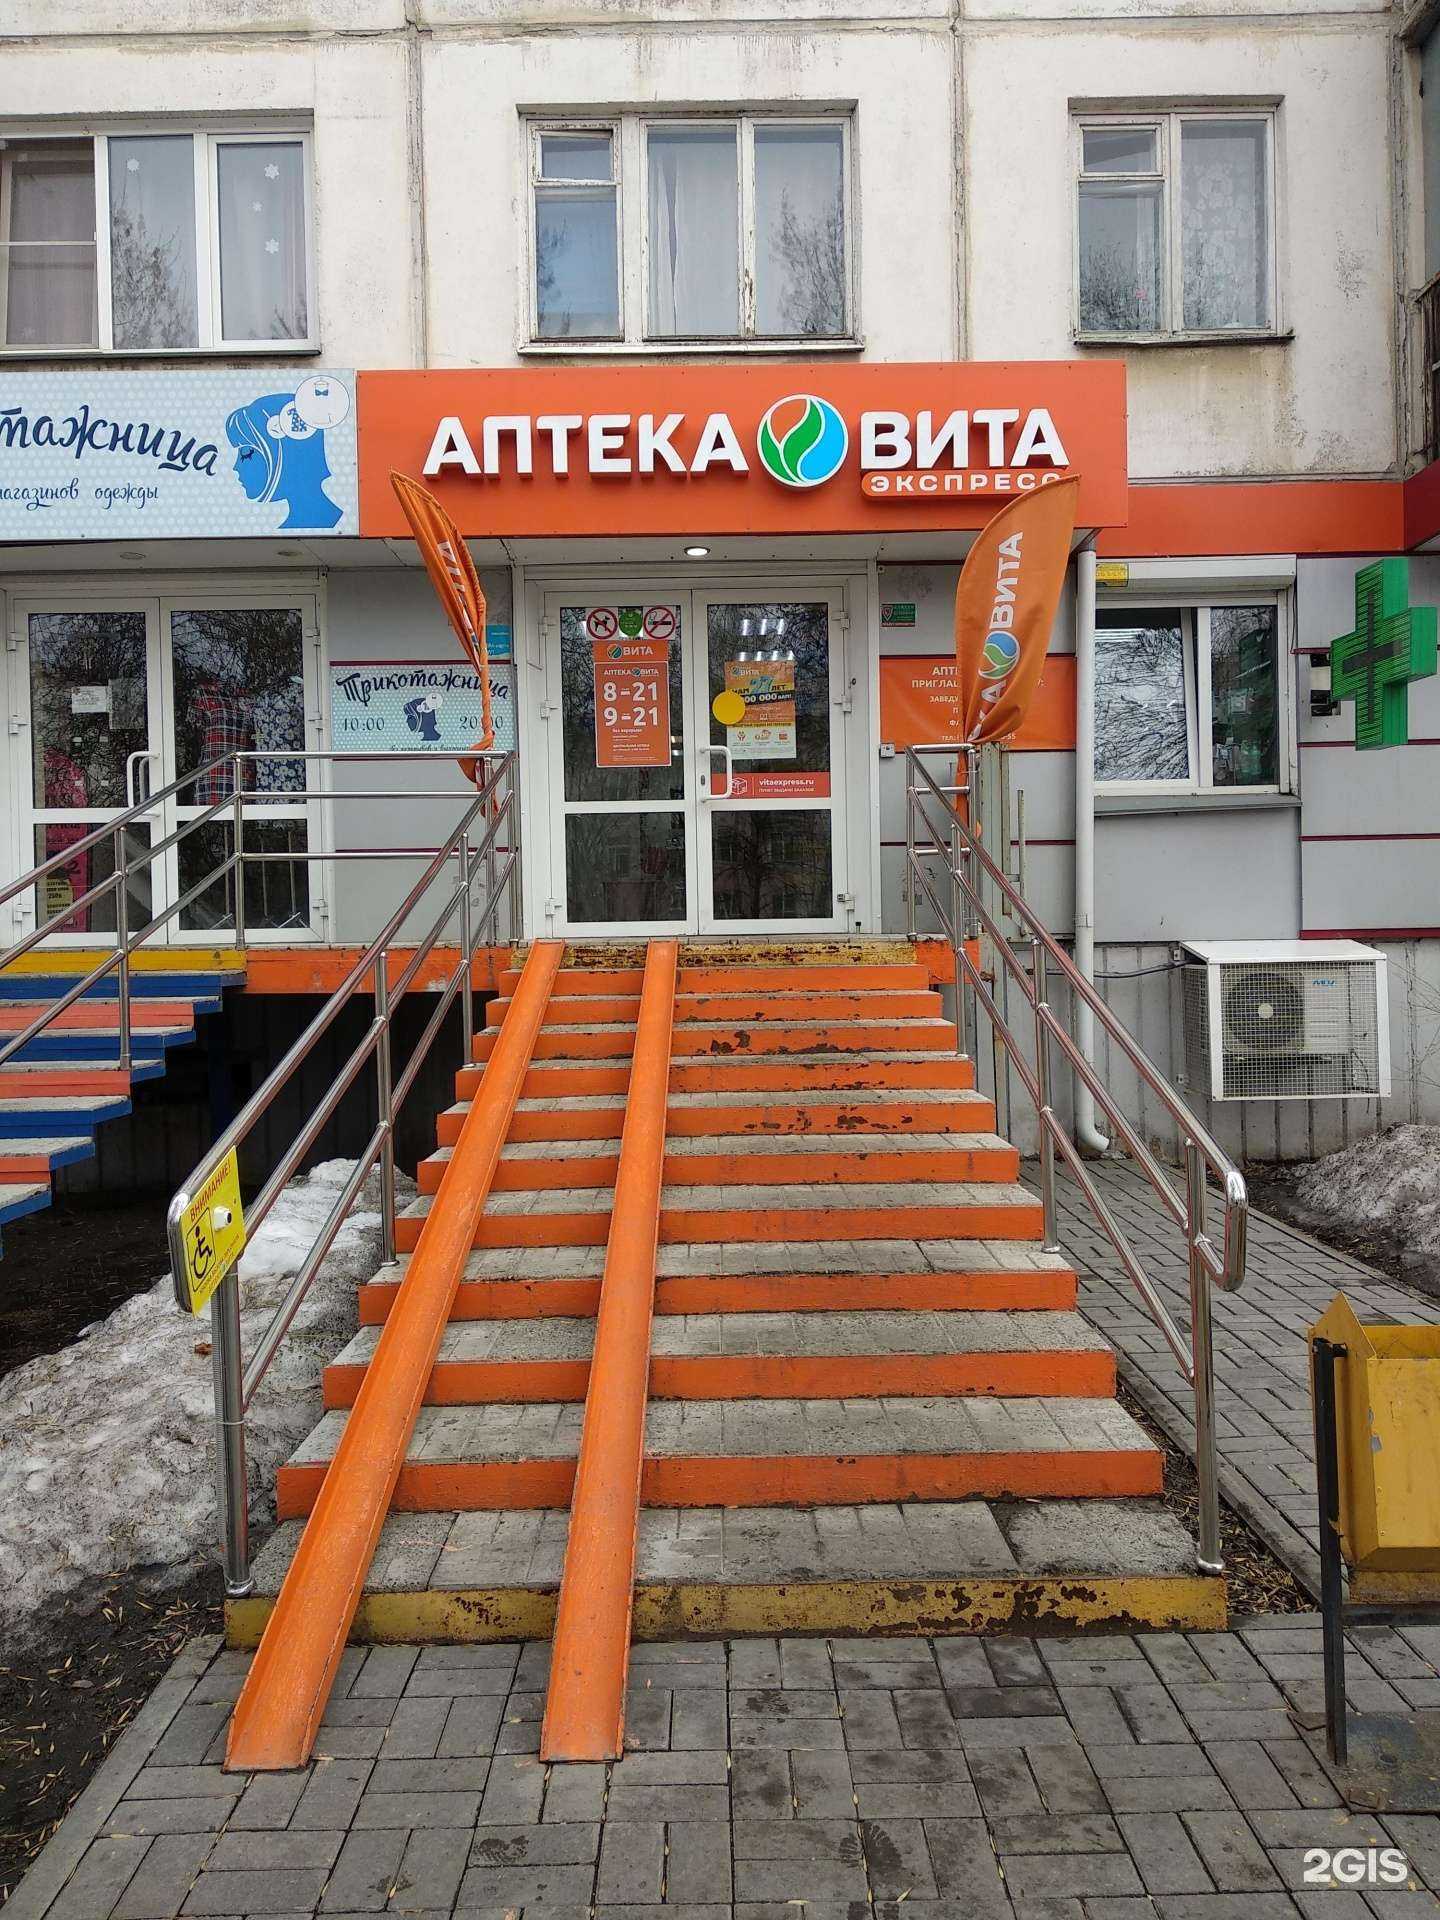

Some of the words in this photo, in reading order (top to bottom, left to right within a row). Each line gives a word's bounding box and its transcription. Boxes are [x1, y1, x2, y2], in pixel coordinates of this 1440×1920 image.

[422, 413, 750, 478] АПТЕКА
[860, 408, 1070, 469] ВИТА
[95, 483, 159, 510] одежды
[989, 531, 1024, 630] ВИТА
[623, 646, 653, 656] ВИТА
[344, 717, 385, 731] 10:00
[759, 779, 814, 788] vitaexpress.ru
[190, 1160, 230, 1223] ВНИМАНИЕ!
